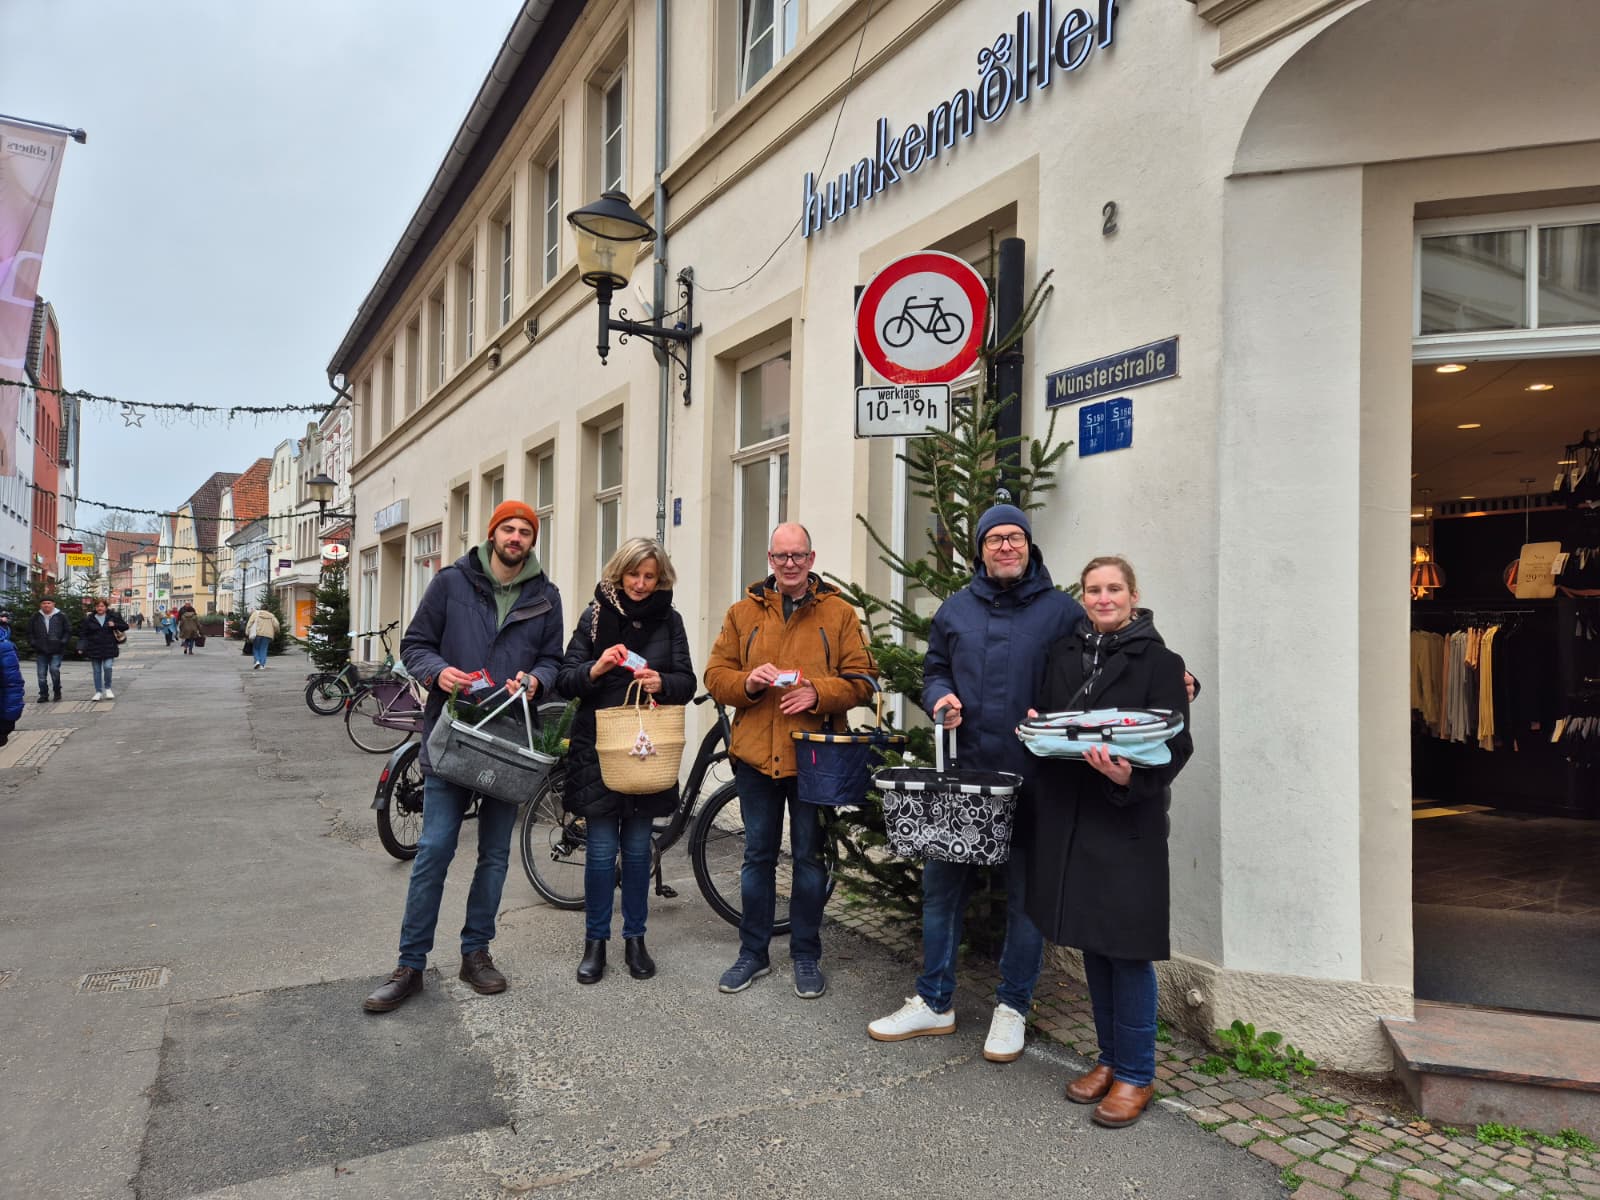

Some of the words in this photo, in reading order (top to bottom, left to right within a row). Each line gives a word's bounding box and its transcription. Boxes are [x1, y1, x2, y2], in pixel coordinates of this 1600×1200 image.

[1102, 201, 1119, 236] 2
[1054, 351, 1167, 400] Münsterstraße
[877, 387, 921, 401] werktags
